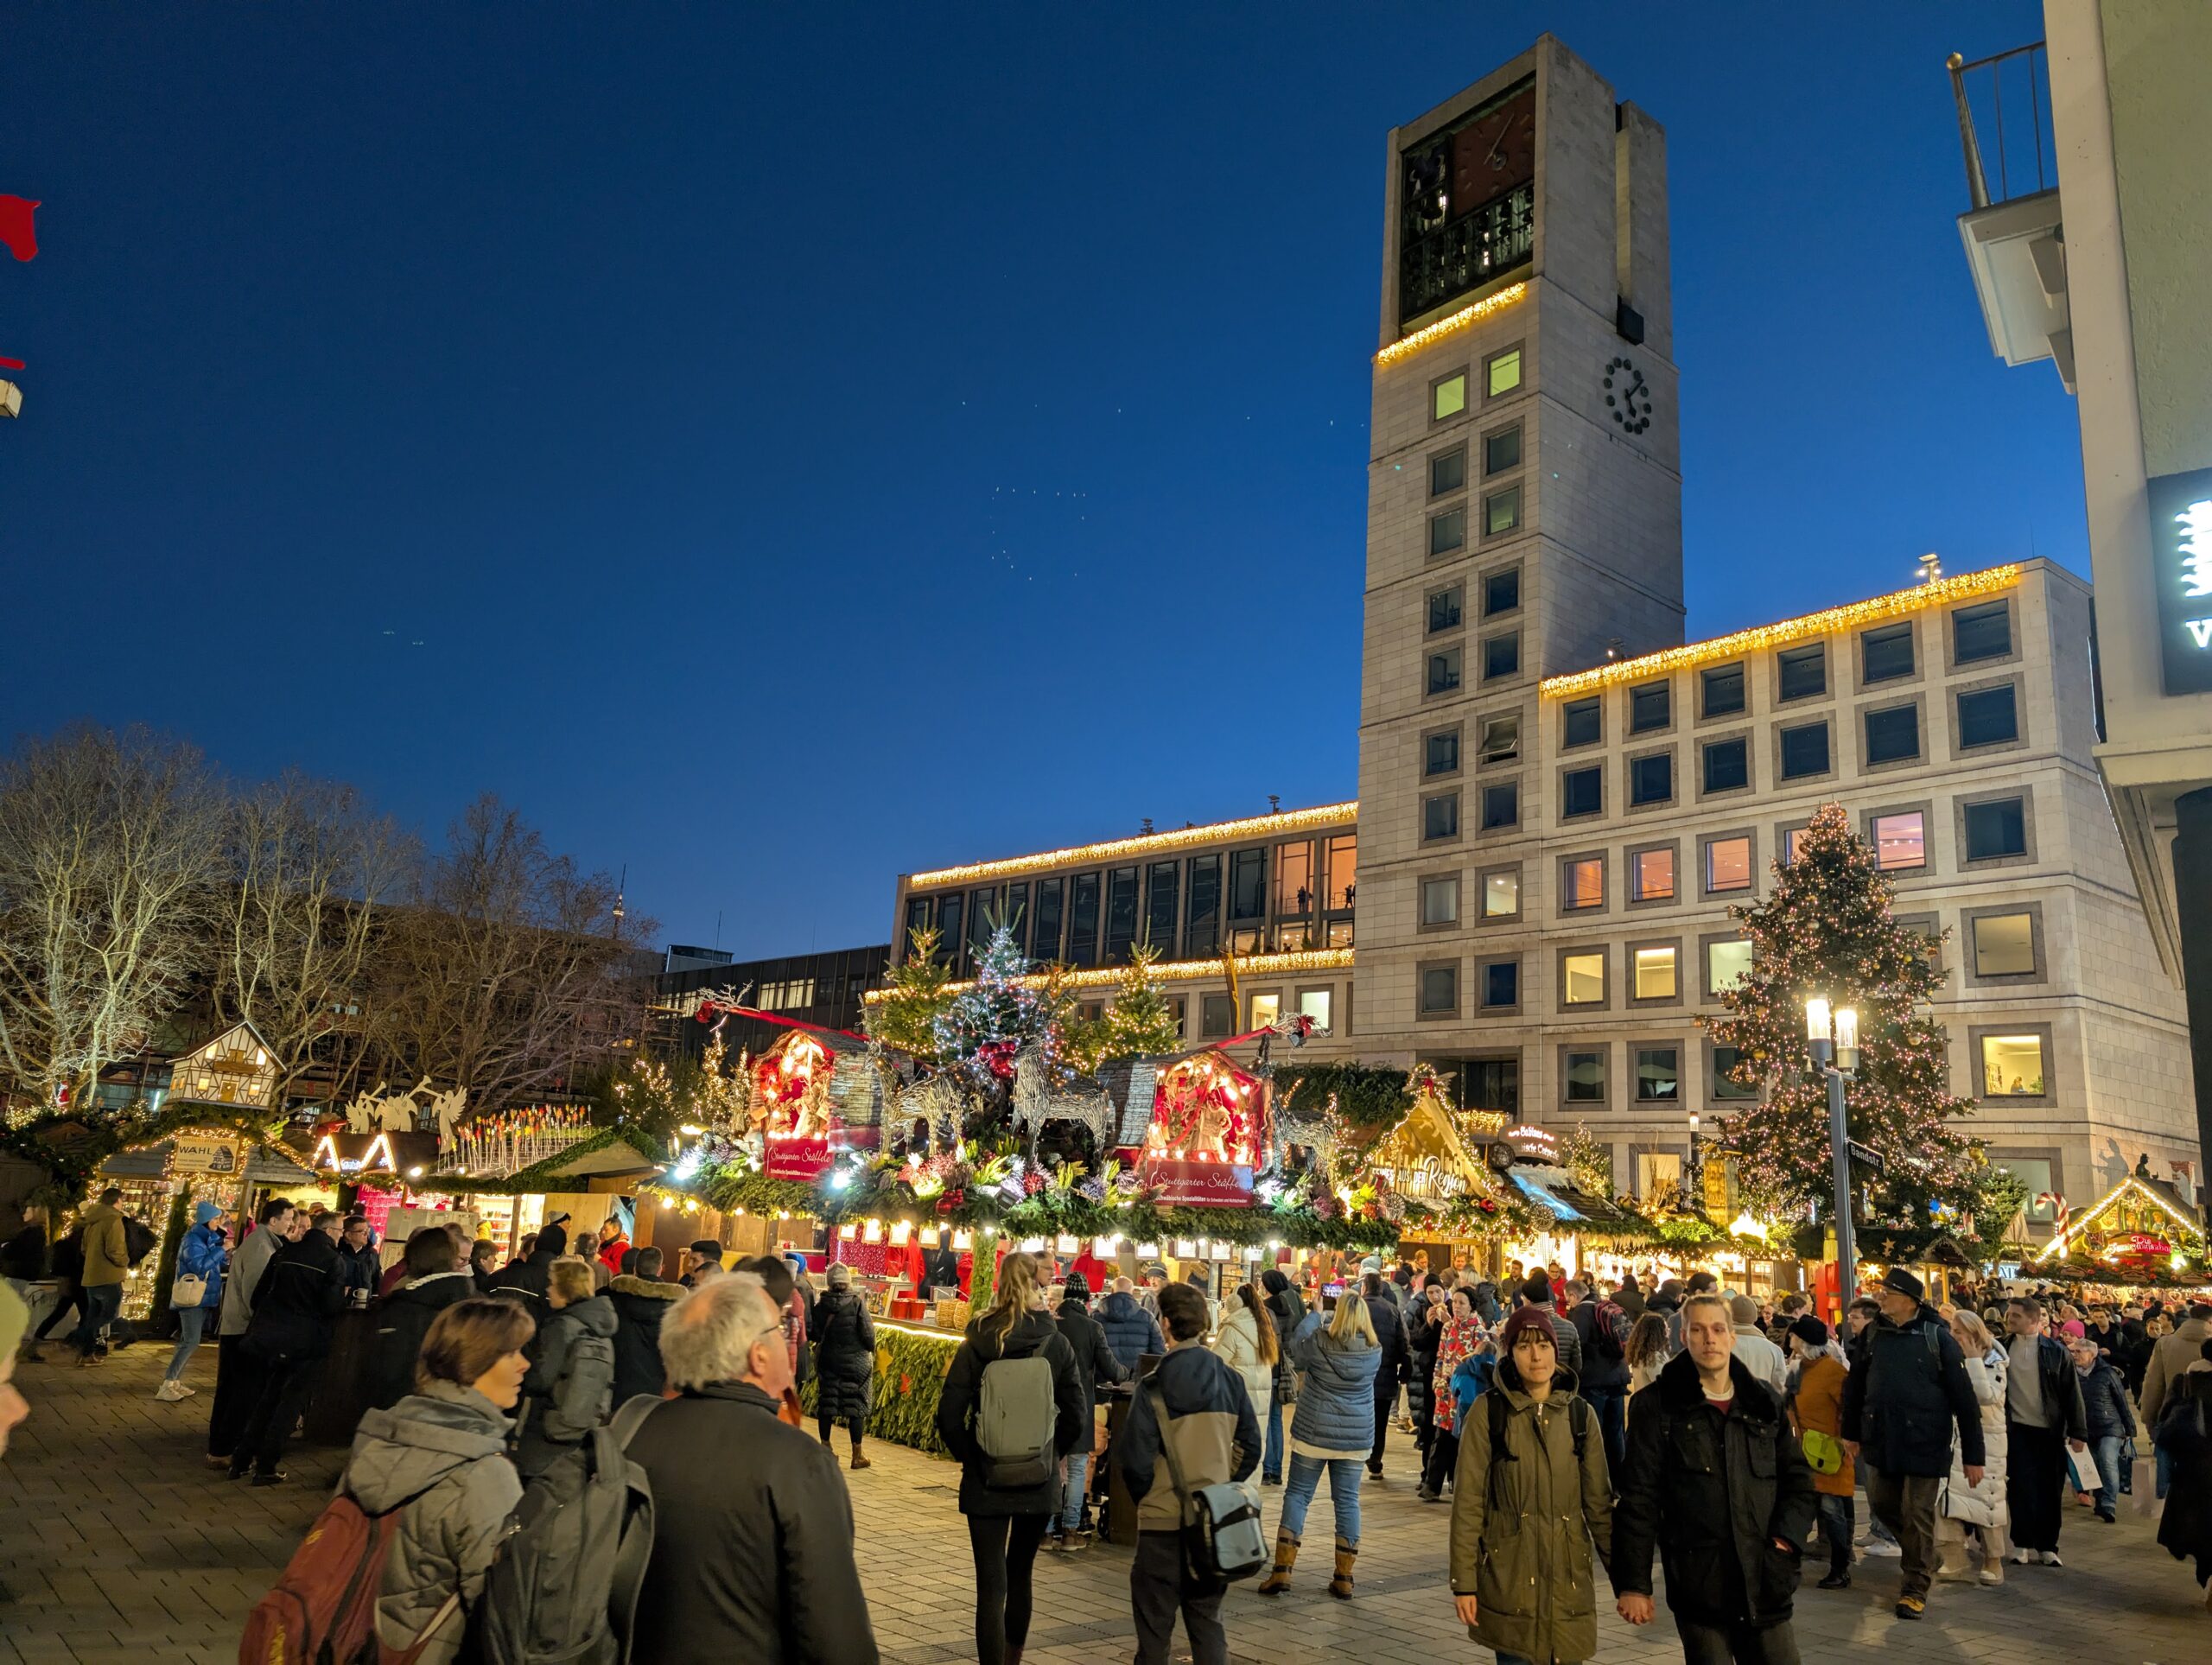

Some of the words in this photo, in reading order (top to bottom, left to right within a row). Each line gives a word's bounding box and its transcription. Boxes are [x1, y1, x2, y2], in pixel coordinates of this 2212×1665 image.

[179, 1146, 213, 1155] WAHL
[771, 1147, 800, 1165] Stuttgarter
[1850, 1144, 1882, 1168] Bandstr.
[1156, 1172, 1206, 1191] Stuttgarter
[1207, 1172, 1239, 1191] Stäffe
[1397, 1169, 1410, 1182] AUS
[1414, 1171, 1427, 1184] DER
[1423, 1155, 1467, 1198] Region
